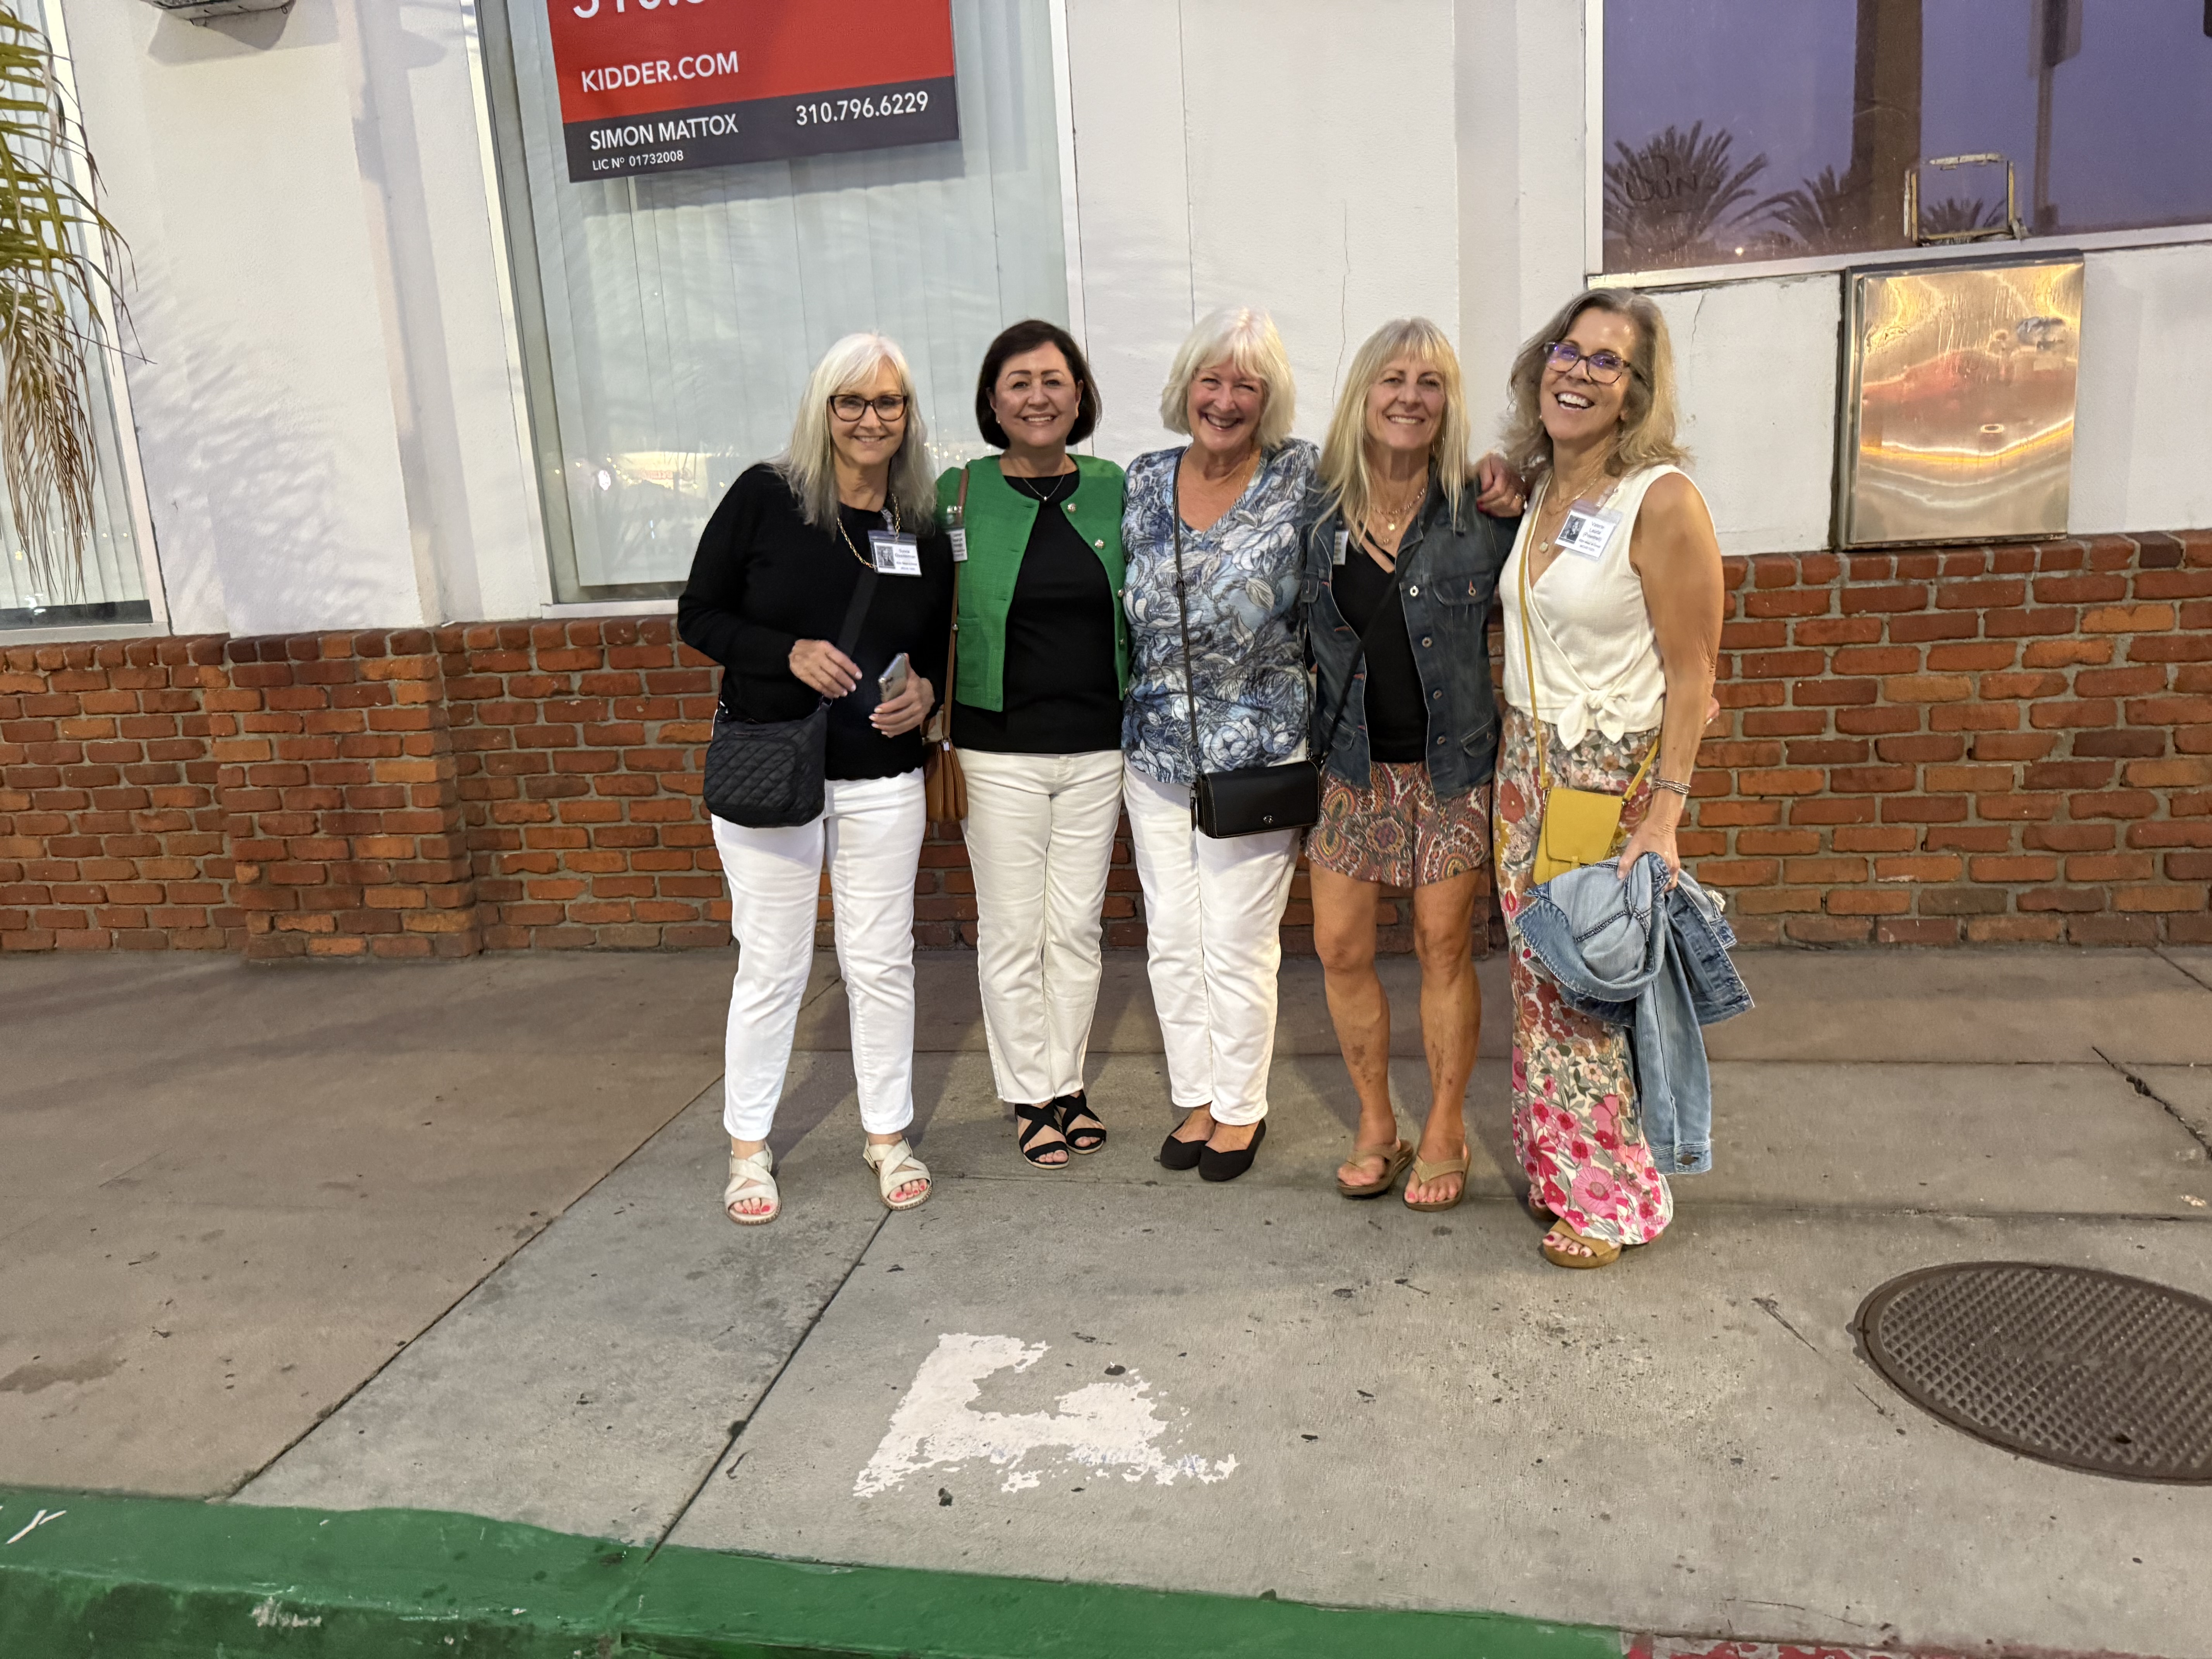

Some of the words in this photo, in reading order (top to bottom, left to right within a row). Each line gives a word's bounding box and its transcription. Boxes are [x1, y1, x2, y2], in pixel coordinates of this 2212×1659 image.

[581, 51, 739, 93] KIDDER.COM
[796, 91, 928, 125] 310.796.6229
[590, 124, 654, 150] SIMON
[659, 113, 738, 142] MATTOX
[592, 158, 609, 171] LIC
[629, 150, 684, 167] 01732008
